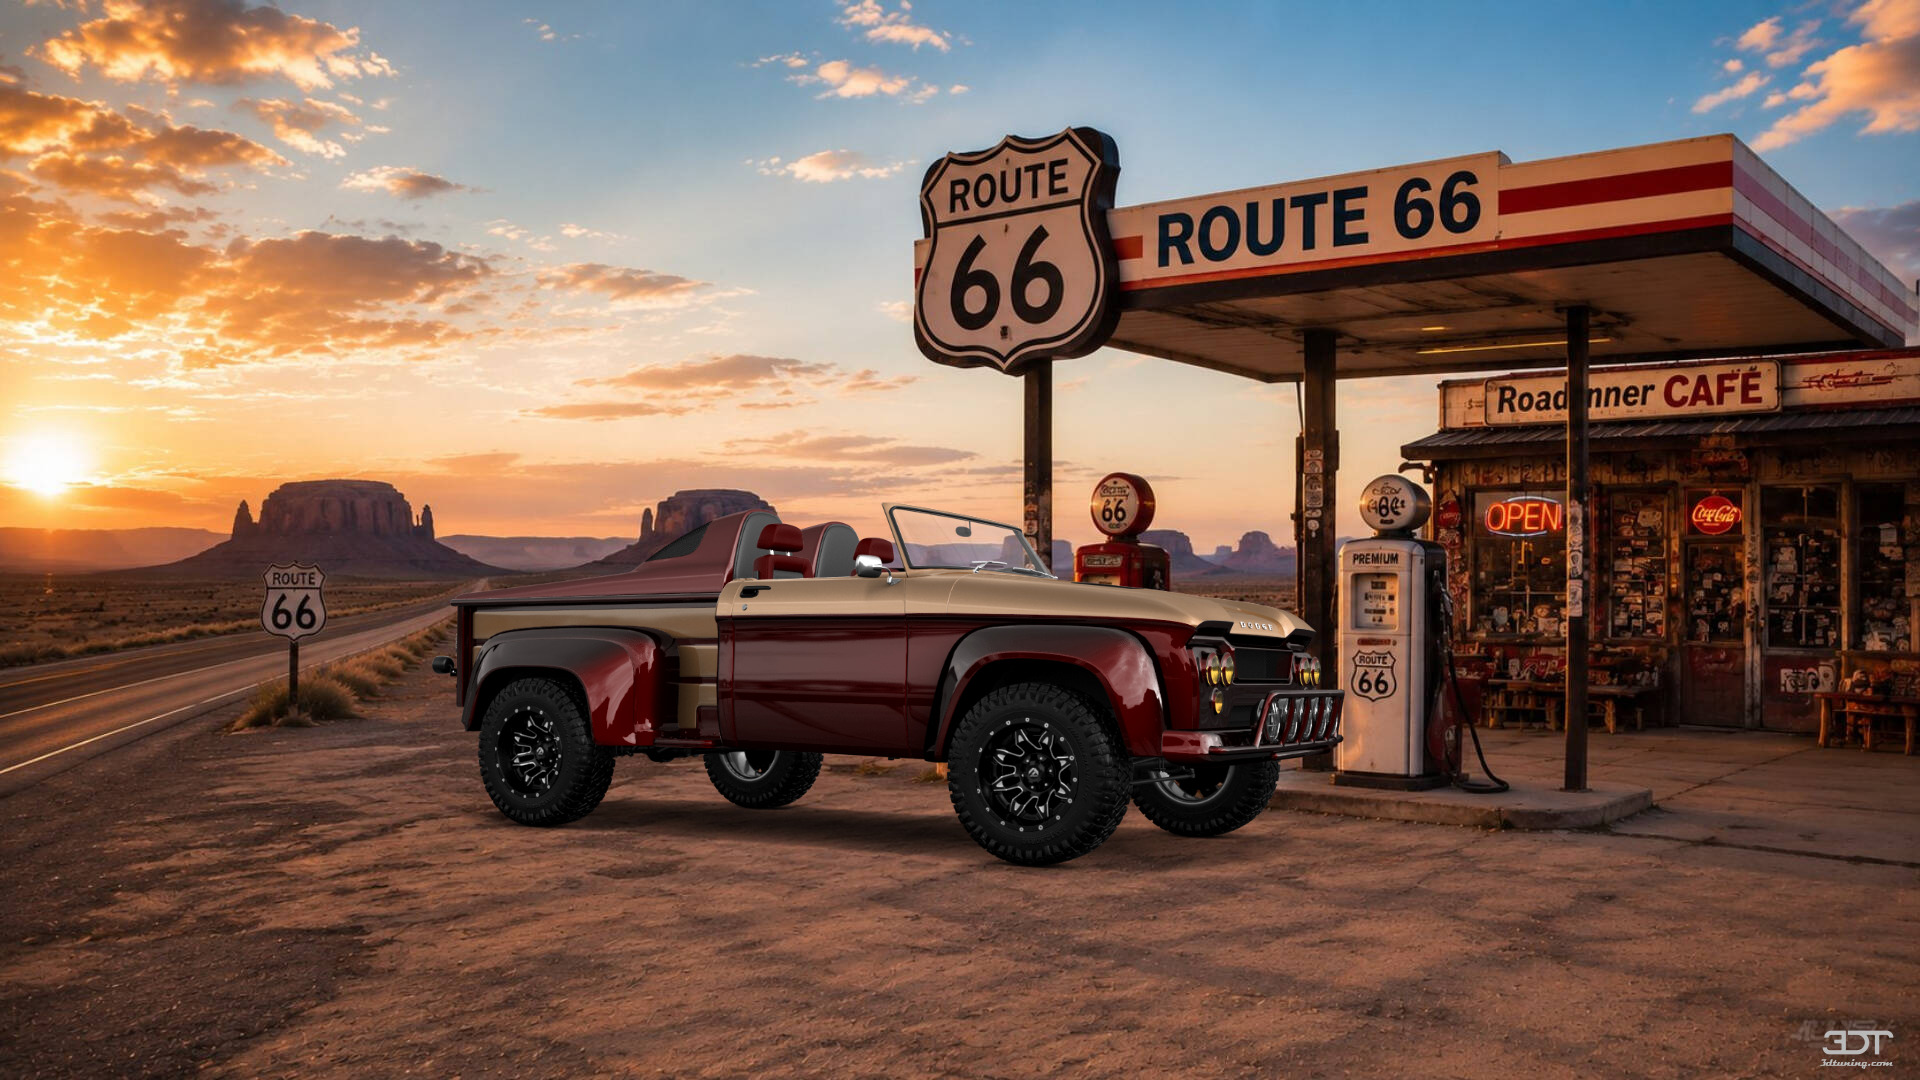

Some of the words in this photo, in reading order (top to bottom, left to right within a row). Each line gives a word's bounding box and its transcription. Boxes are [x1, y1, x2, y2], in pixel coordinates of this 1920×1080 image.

[949, 158, 1069, 213] ROUTE
[1158, 186, 1369, 267] ROUTE
[1394, 171, 1481, 240] 66
[950, 224, 1064, 330] 66
[1101, 499, 1126, 522] 66
[1487, 503, 1559, 531] OPEN
[1352, 553, 1399, 565] PREMIUM
[272, 572, 316, 586] ROUTE
[271, 593, 316, 630] 66
[1358, 655, 1388, 665] ROUTE
[1358, 669, 1389, 694] 66
